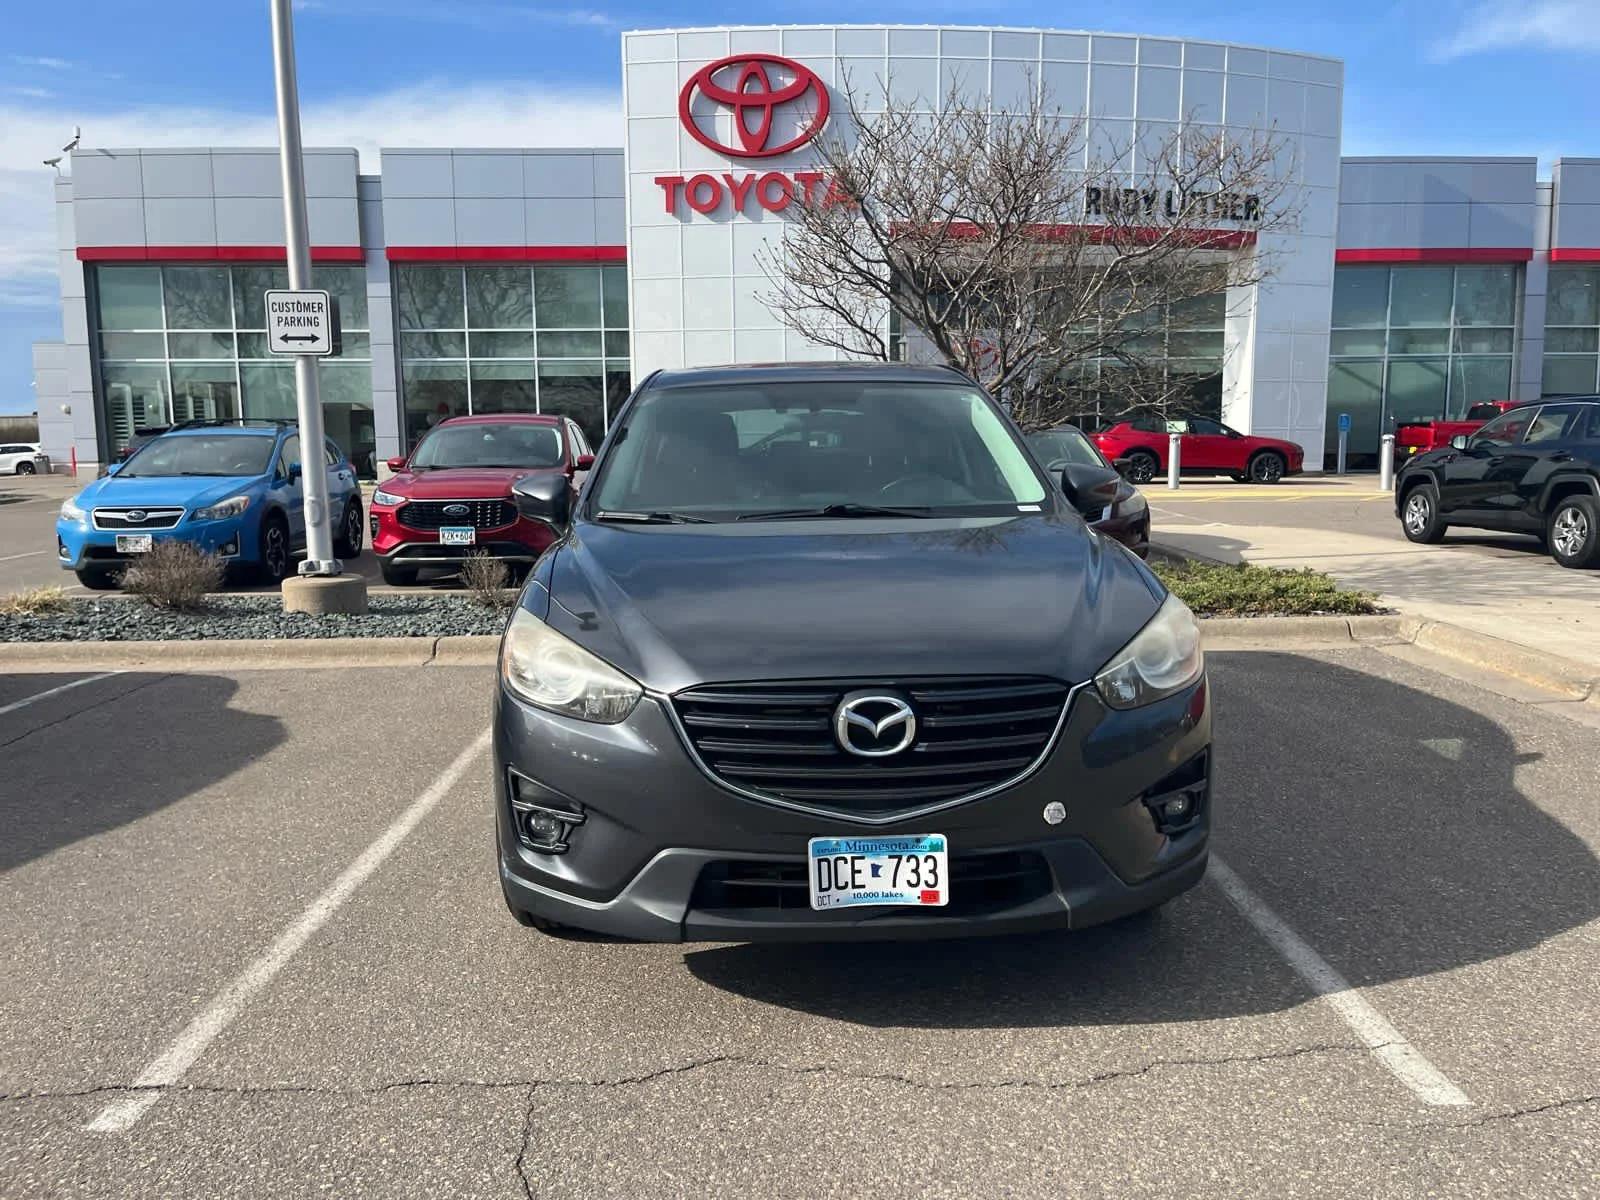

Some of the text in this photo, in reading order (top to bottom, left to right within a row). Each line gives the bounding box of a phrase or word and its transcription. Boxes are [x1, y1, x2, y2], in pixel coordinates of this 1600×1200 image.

[654, 171, 859, 215] TOYOTA
[271, 301, 324, 313] CUSTOMER
[277, 316, 320, 328] PARKING
[816, 854, 939, 893] DCE 733
[817, 894, 832, 907] OCT
[852, 890, 904, 900] 10,000 lakes
